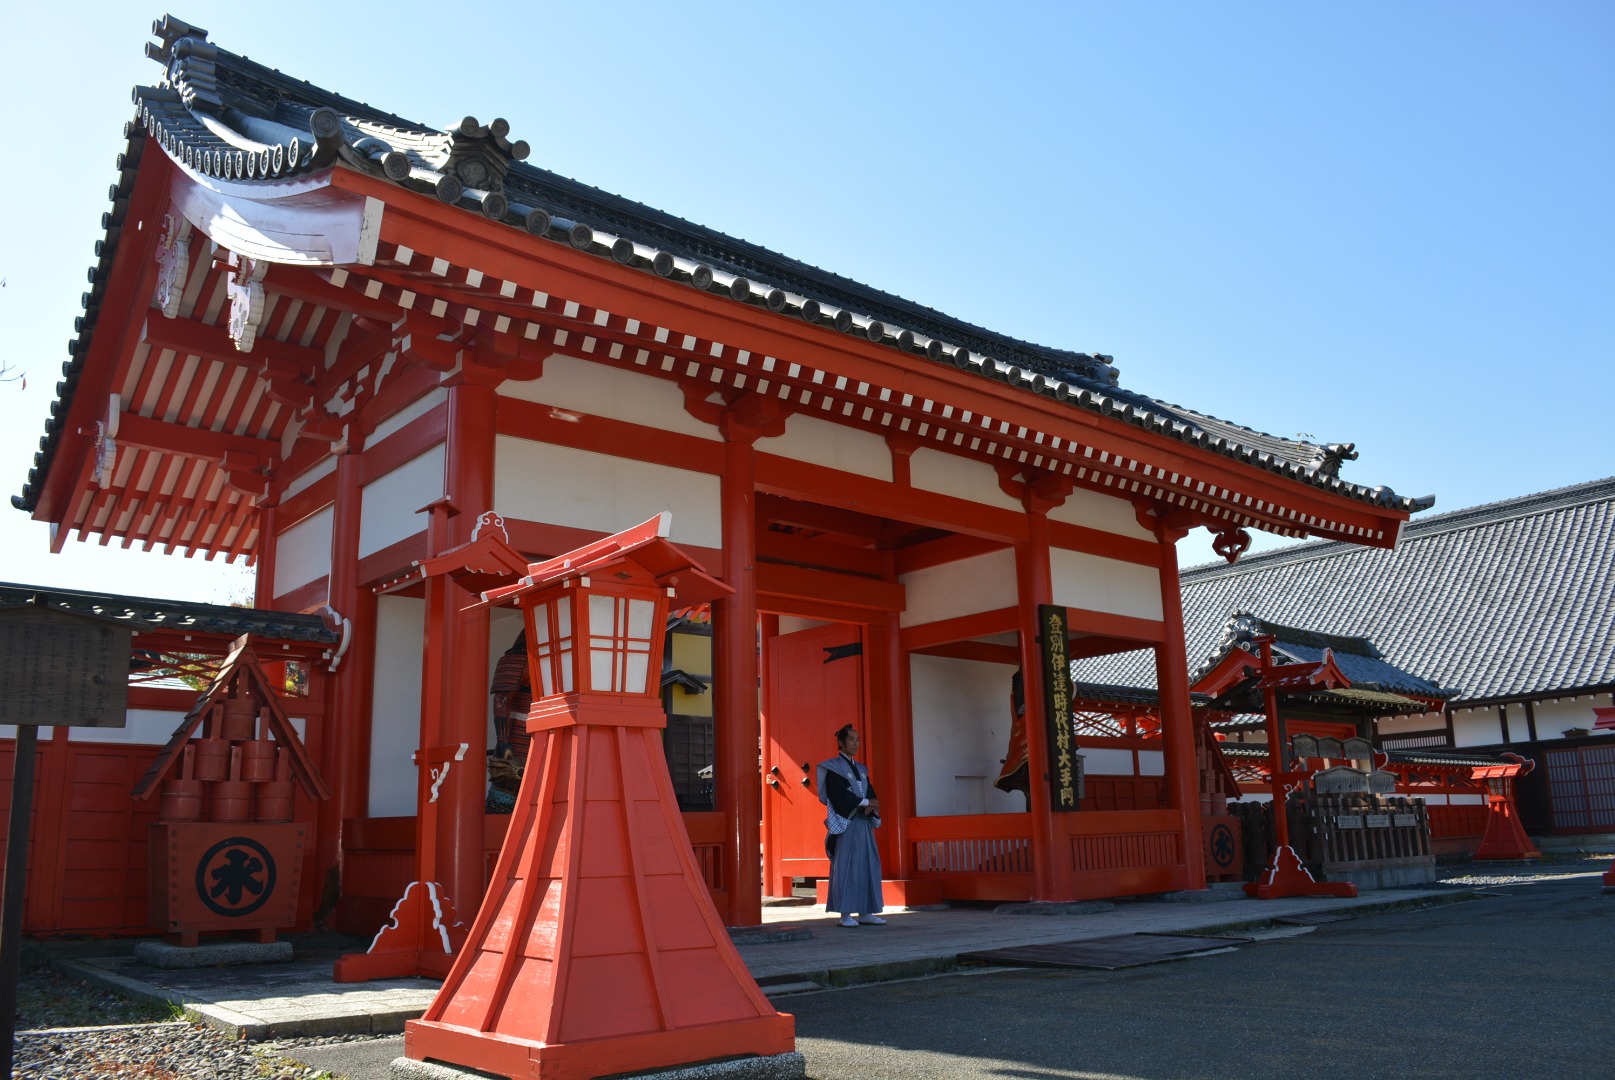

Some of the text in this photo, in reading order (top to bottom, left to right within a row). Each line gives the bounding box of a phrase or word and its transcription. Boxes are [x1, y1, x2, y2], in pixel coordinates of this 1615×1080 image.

[1049, 613, 1074, 807] 登別伊達時代村大手門
[211, 849, 263, 905] 水
